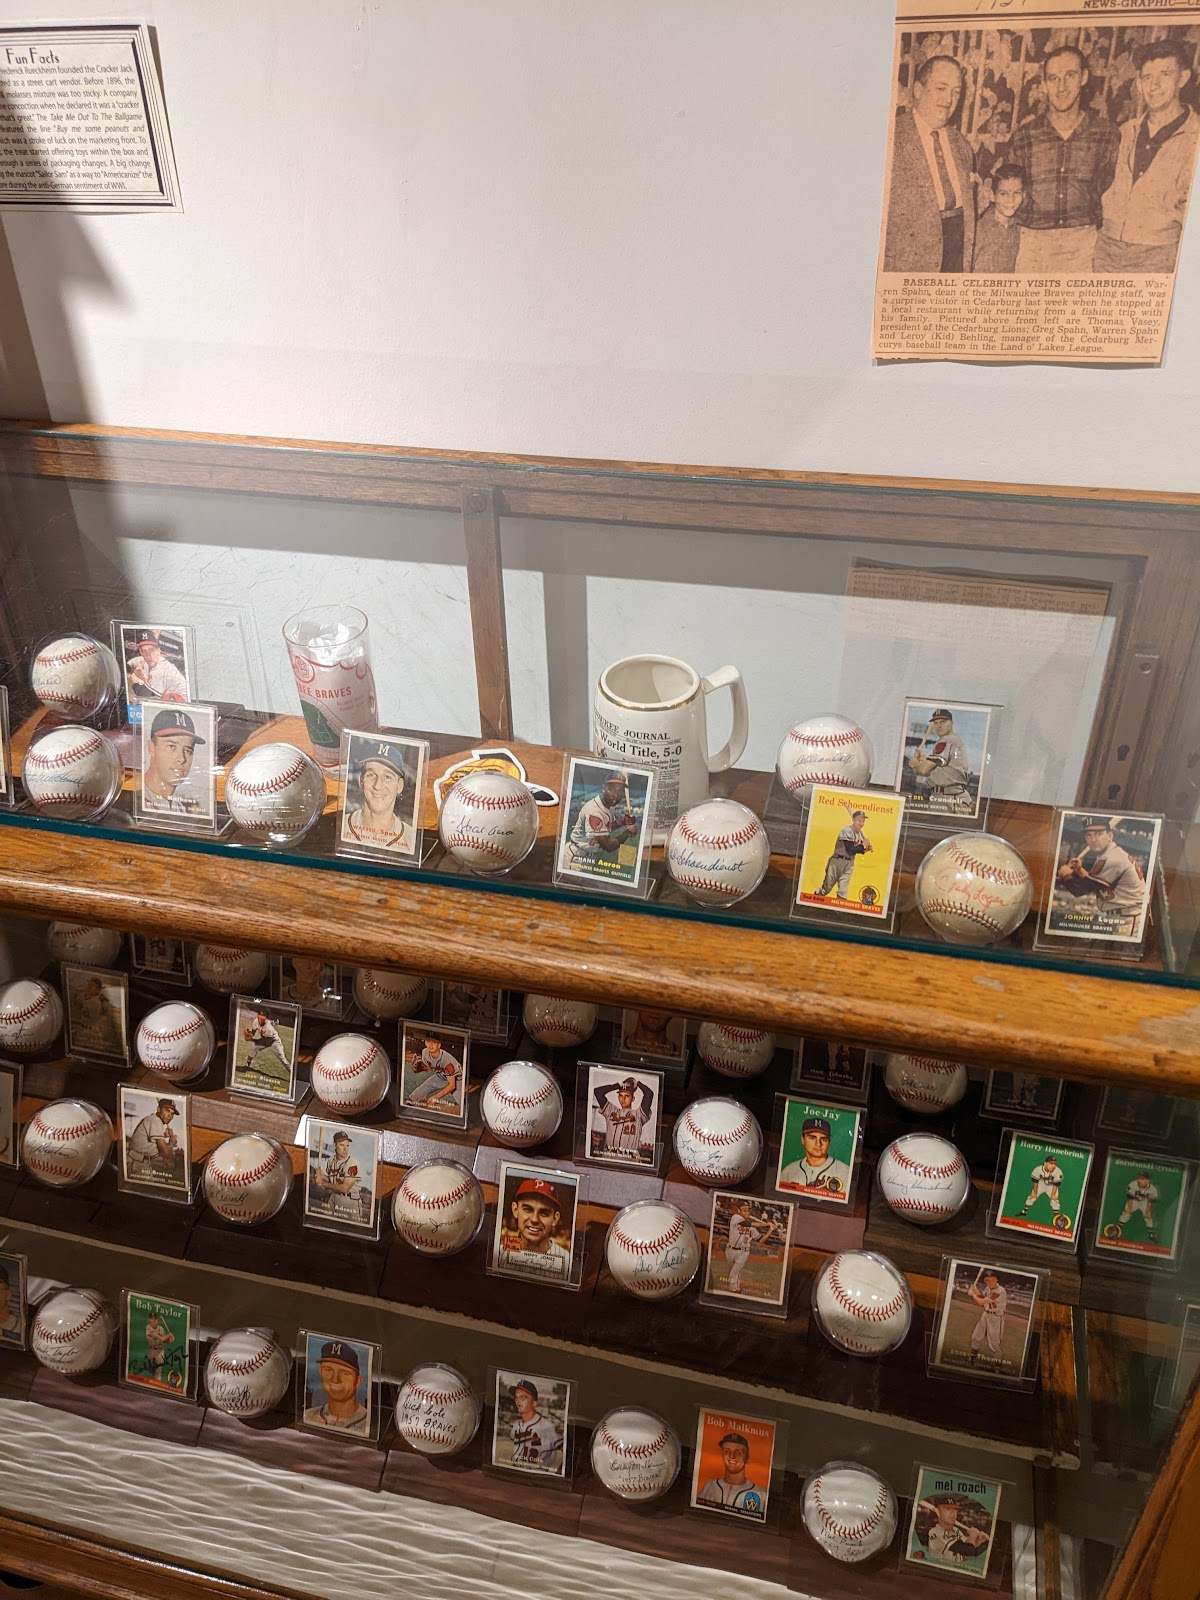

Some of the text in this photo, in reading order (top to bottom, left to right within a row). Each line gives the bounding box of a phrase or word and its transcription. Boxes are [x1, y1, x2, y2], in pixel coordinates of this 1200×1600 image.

[6, 47, 60, 64] Fun Facts
[96, 65, 118, 73] Cracker
[84, 77, 103, 85] Before
[110, 90, 137, 98] company
[115, 112, 142, 122] Ballgame
[89, 136, 120, 145] marketing
[52, 148, 74, 157] offering
[116, 160, 126, 168] big
[129, 160, 150, 168] change
[904, 278, 957, 287] BASEBALL
[962, 279, 1021, 288] CELEBRITY
[1027, 280, 1061, 288] VISITS
[1066, 280, 1136, 288] CEDARBURG.
[902, 288, 931, 297] Spahn,
[972, 289, 987, 297] the
[990, 289, 1040, 298] Milwaukee
[1044, 289, 1075, 298] Braves
[1079, 290, 1117, 298] pitching
[1120, 290, 1143, 298] staff,
[974, 299, 1021, 307] Cedarburg
[1115, 300, 1151, 308] stopped
[996, 308, 1039, 316] returning
[1081, 308, 1114, 317] fishing
[1118, 309, 1135, 318] trip
[1141, 309, 1162, 317] with
[939, 315, 977, 324] Pictured
[1044, 316, 1059, 325] left
[1088, 317, 1124, 326] Thomas
[880, 324, 921, 332] president
[935, 324, 949, 332] the
[952, 324, 998, 334] Cedarburg
[1001, 325, 1029, 334] Lions;
[1032, 326, 1054, 335] Greg
[1057, 326, 1088, 335] Spahn,
[1093, 326, 1127, 335] Warren
[1129, 327, 1159, 336] Spahn
[901, 333, 925, 342] Leroy
[932, 333, 954, 342] (Kid)
[960, 334, 996, 343] Behling,
[1002, 336, 1040, 344] manager
[1045, 335, 1055, 343] of
[1060, 335, 1075, 343] the
[1080, 335, 1129, 345] Cedarburg
[1135, 336, 1158, 344] Mer-
[906, 340, 941, 349] baseball
[944, 342, 967, 350] team
[970, 342, 978, 350] in
[982, 342, 996, 350] the
[1000, 343, 1023, 351] Land
[1038, 344, 1065, 352] Lakes
[1069, 344, 1104, 354] League.
[315, 686, 352, 699] BRAVES
[175, 712, 186, 726] M
[624, 730, 670, 740] JOURNAL
[378, 744, 390, 756] M
[600, 730, 682, 759] World Title, 5-0
[818, 795, 836, 806] Red
[837, 798, 894, 816] Schoendienst
[598, 859, 621, 869] Aaron
[1064, 914, 1126, 924] JOHNNY Logan
[803, 1106, 841, 1120] Joe Jay
[1020, 1140, 1084, 1159] Harry Hanebrink
[534, 1179, 544, 1190] P
[136, 1300, 182, 1318] Bob Taylor
[331, 1344, 344, 1356] M
[424, 1418, 457, 1433] BRAVES
[706, 1415, 769, 1438] Bob Malkmus
[935, 1480, 986, 1494] mel roach
